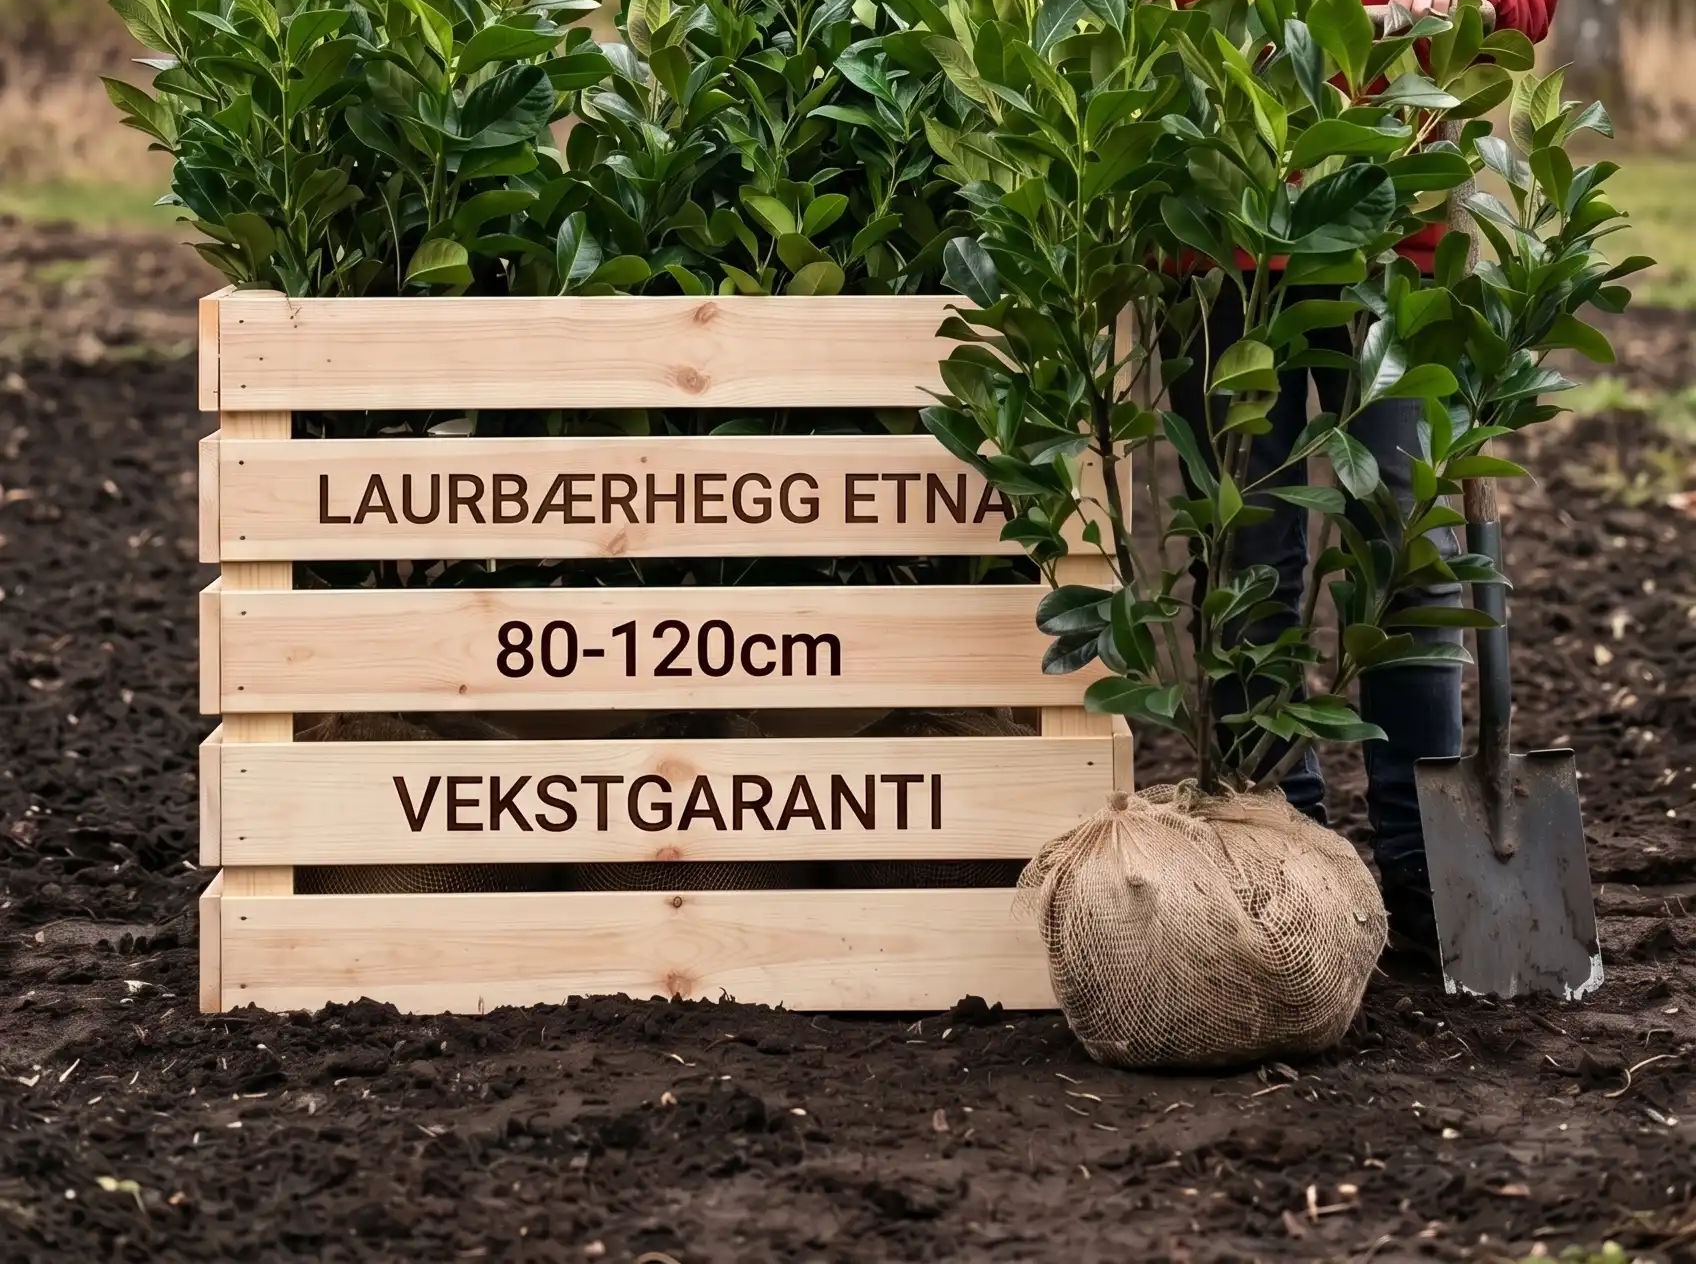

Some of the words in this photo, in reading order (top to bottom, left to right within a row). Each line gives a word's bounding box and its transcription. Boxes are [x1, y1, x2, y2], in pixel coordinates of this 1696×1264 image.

[319, 473, 820, 525] LAURBÆRHEGG
[845, 473, 1016, 525] ETNA
[496, 620, 841, 678] 80-120cm
[392, 773, 942, 833] VEKSTGARANTI
